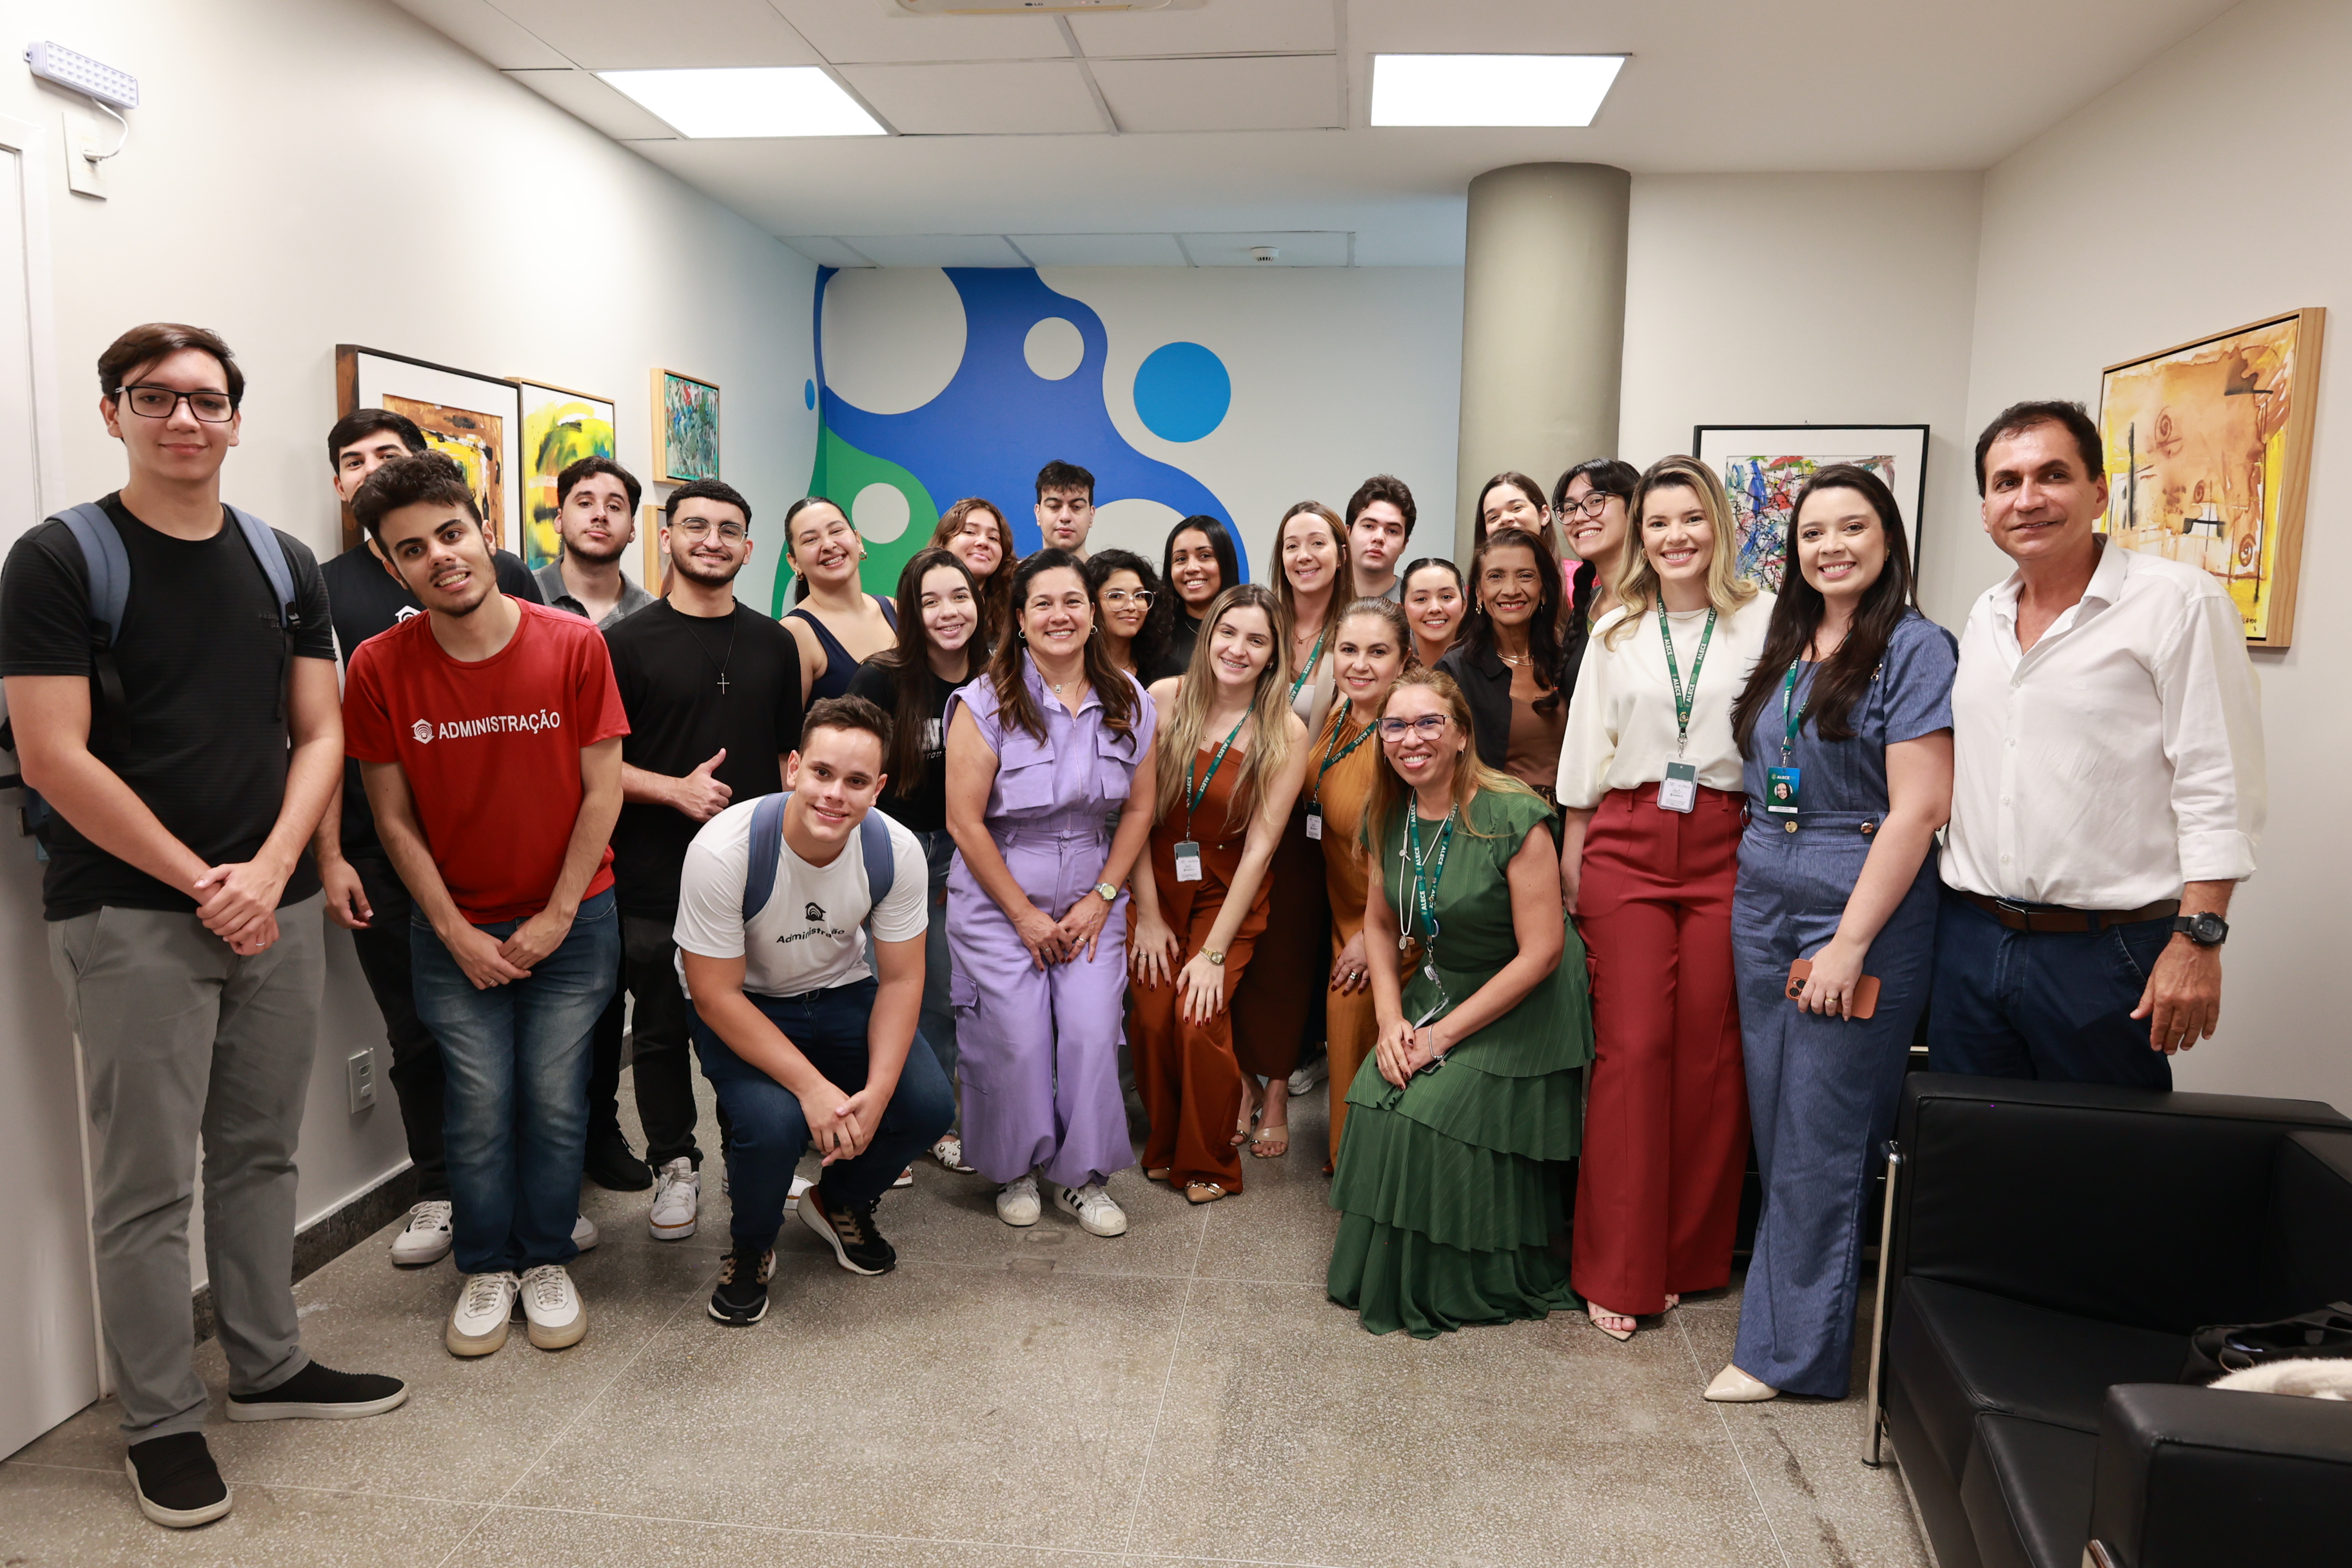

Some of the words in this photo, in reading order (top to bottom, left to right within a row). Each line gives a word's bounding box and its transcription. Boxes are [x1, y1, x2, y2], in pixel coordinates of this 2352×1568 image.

[1664, 639, 1673, 656] ALECE
[1697, 643, 1707, 660] ALECE
[1302, 660, 1313, 674] ALECE
[1672, 678, 1681, 697] ALECE
[1686, 683, 1695, 703] ALECE
[439, 709, 560, 740] ADMINISTRAÇÃO
[1353, 731, 1367, 745] ALECE
[1216, 742, 1228, 759] ALECE
[1199, 776, 1210, 793] ALECE
[1449, 802, 1458, 822] ALECE
[776, 926, 845, 943] Administraão
